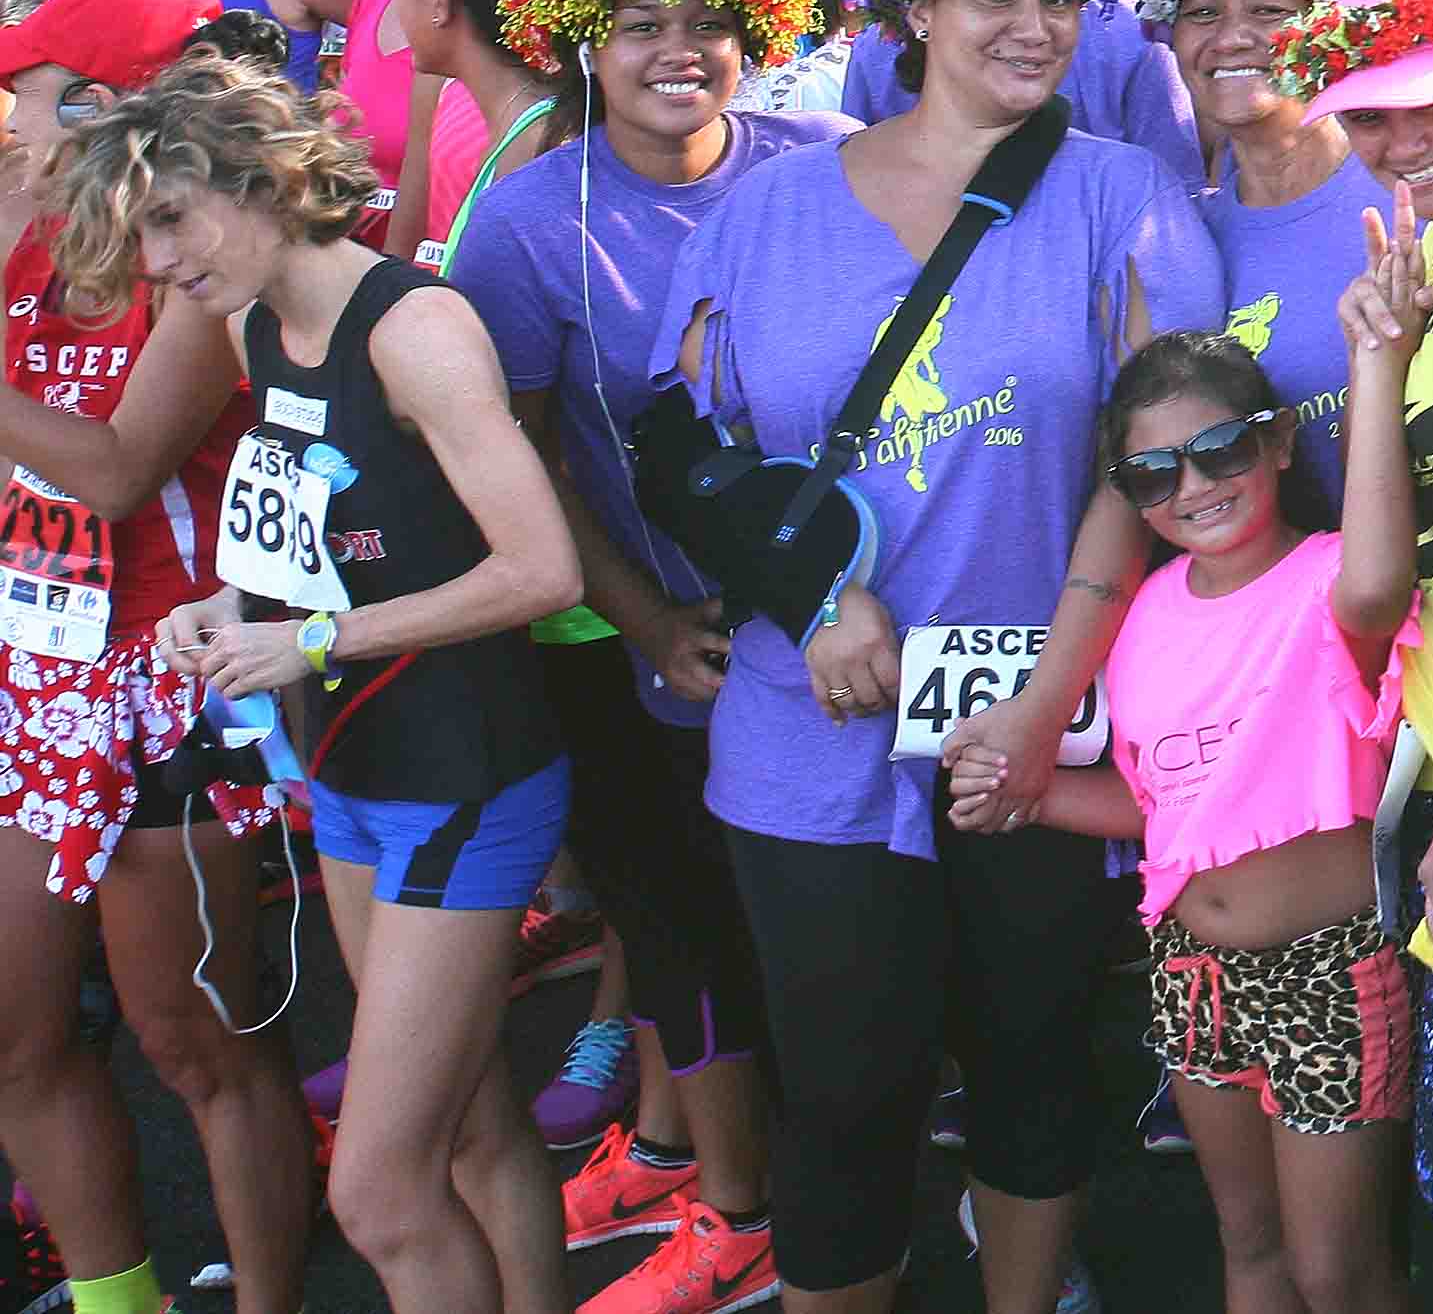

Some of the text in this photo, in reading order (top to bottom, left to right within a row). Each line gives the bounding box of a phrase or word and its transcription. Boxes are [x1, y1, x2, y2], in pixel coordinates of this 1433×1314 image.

[15, 343, 129, 378] SCEP
[984, 426, 1024, 446] 2016
[228, 478, 322, 576] 589
